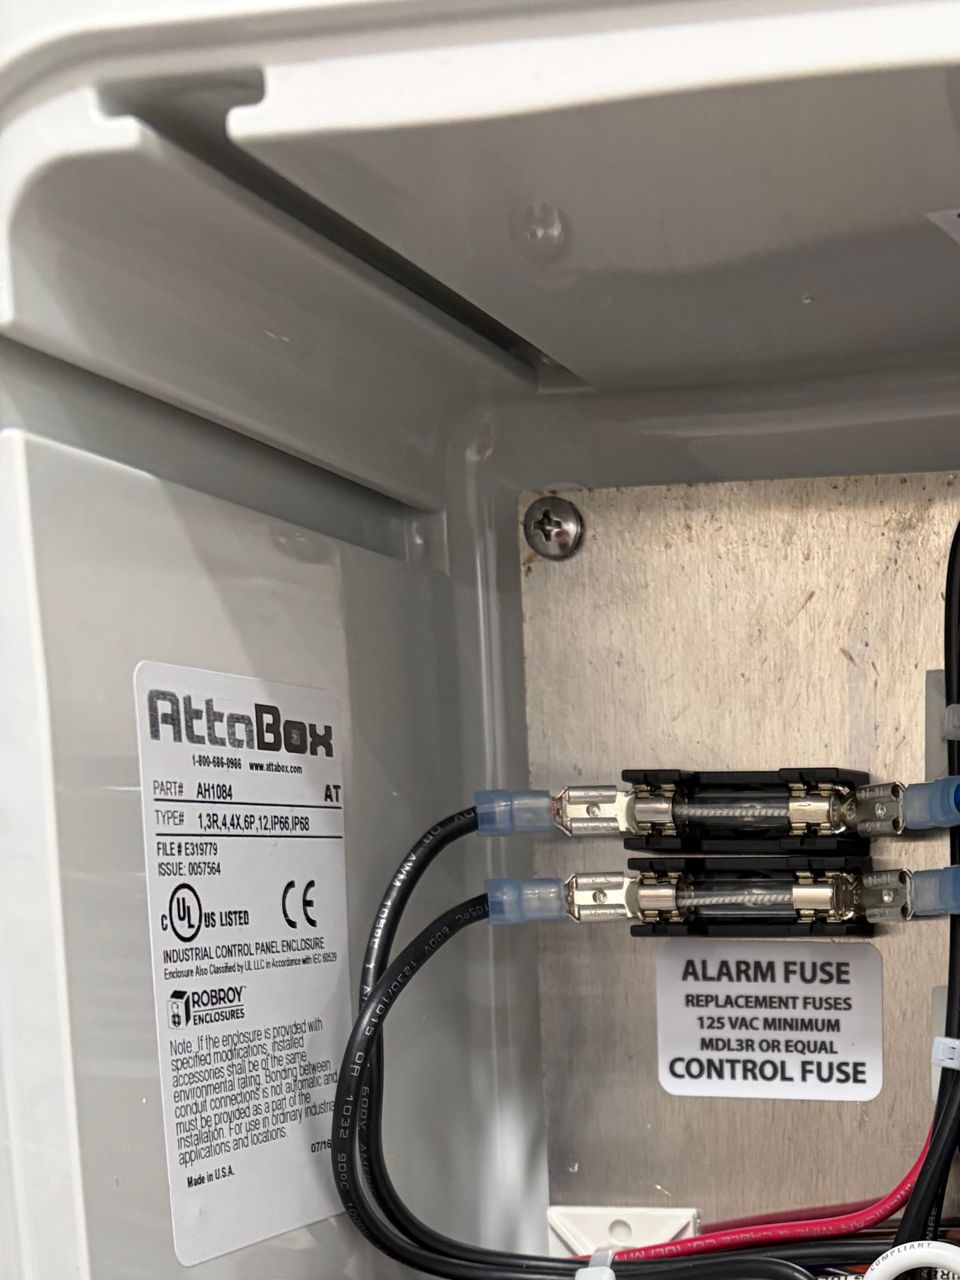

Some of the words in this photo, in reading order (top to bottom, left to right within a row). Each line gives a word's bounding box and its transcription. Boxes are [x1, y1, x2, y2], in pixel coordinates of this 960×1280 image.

[153, 780, 184, 797] PART#
[196, 782, 233, 800] AH1084
[324, 785, 342, 802] AT
[154, 810, 185, 826] TYPE#
[157, 842, 176, 856] FILE
[158, 863, 187, 876] ISSUE:
[220, 910, 250, 927] LISTED
[163, 945, 214, 964] INDUSTRIAL
[215, 943, 254, 959] CONTROL
[255, 941, 281, 955] PANEL
[281, 937, 325, 951] ENCLOSURE
[164, 966, 194, 980] Enclosure
[195, 965, 208, 977] Also
[209, 962, 236, 976] Classified
[253, 958, 265, 970] LLC
[272, 955, 301, 968] Accordance
[313, 953, 322, 964] IEC
[682, 960, 776, 983] ALARM
[784, 961, 851, 984] FUSE
[192, 987, 244, 1009] ROBROY
[685, 994, 799, 1010] REPLACEMENT
[802, 997, 852, 1011] FUSES
[193, 1008, 246, 1026] ENCLOSURES
[698, 1016, 725, 1029] 125
[728, 1017, 759, 1031] VAC
[763, 1018, 841, 1032] MINIMUM
[206, 1035, 220, 1049] the
[221, 1028, 262, 1048] enclosure
[264, 1028, 271, 1040] is
[272, 1019, 306, 1041] provided
[308, 1018, 323, 1033] with
[171, 1052, 211, 1074] specified
[272, 1036, 304, 1051] installed
[701, 1038, 755, 1052] MDL3R
[758, 1039, 781, 1053] OR
[785, 1040, 838, 1055] EQUAL
[172, 1065, 225, 1088] accessories
[226, 1061, 247, 1077] shall
[248, 1059, 259, 1072] be
[270, 1053, 283, 1068] the
[285, 1051, 307, 1066] same
[173, 1079, 235, 1102] environmental
[265, 1065, 298, 1084] Bonding
[300, 1060, 331, 1076] between
[669, 1058, 794, 1082] CONTROL
[801, 1061, 867, 1084] FUSE
[175, 1101, 207, 1119] conduit
[209, 1087, 260, 1111] connections
[262, 1086, 269, 1098] is
[270, 1083, 283, 1096] not
[285, 1075, 321, 1093] automatic
[323, 1072, 338, 1084] and
[176, 1119, 198, 1136] must
[201, 1115, 212, 1128] be
[214, 1107, 250, 1126] provided
[252, 1103, 262, 1116] as
[272, 1097, 287, 1115] part
[289, 1093, 298, 1108] of
[298, 1091, 311, 1104] the
[229, 1122, 242, 1137] For
[245, 1118, 260, 1133] use
[262, 1116, 269, 1127] in
[272, 1107, 302, 1126] ordinary
[340, 1095, 354, 1139] 1032
[179, 1142, 231, 1168] applications
[233, 1136, 249, 1151] and
[187, 1173, 205, 1188] Made
[206, 1170, 214, 1182] in
